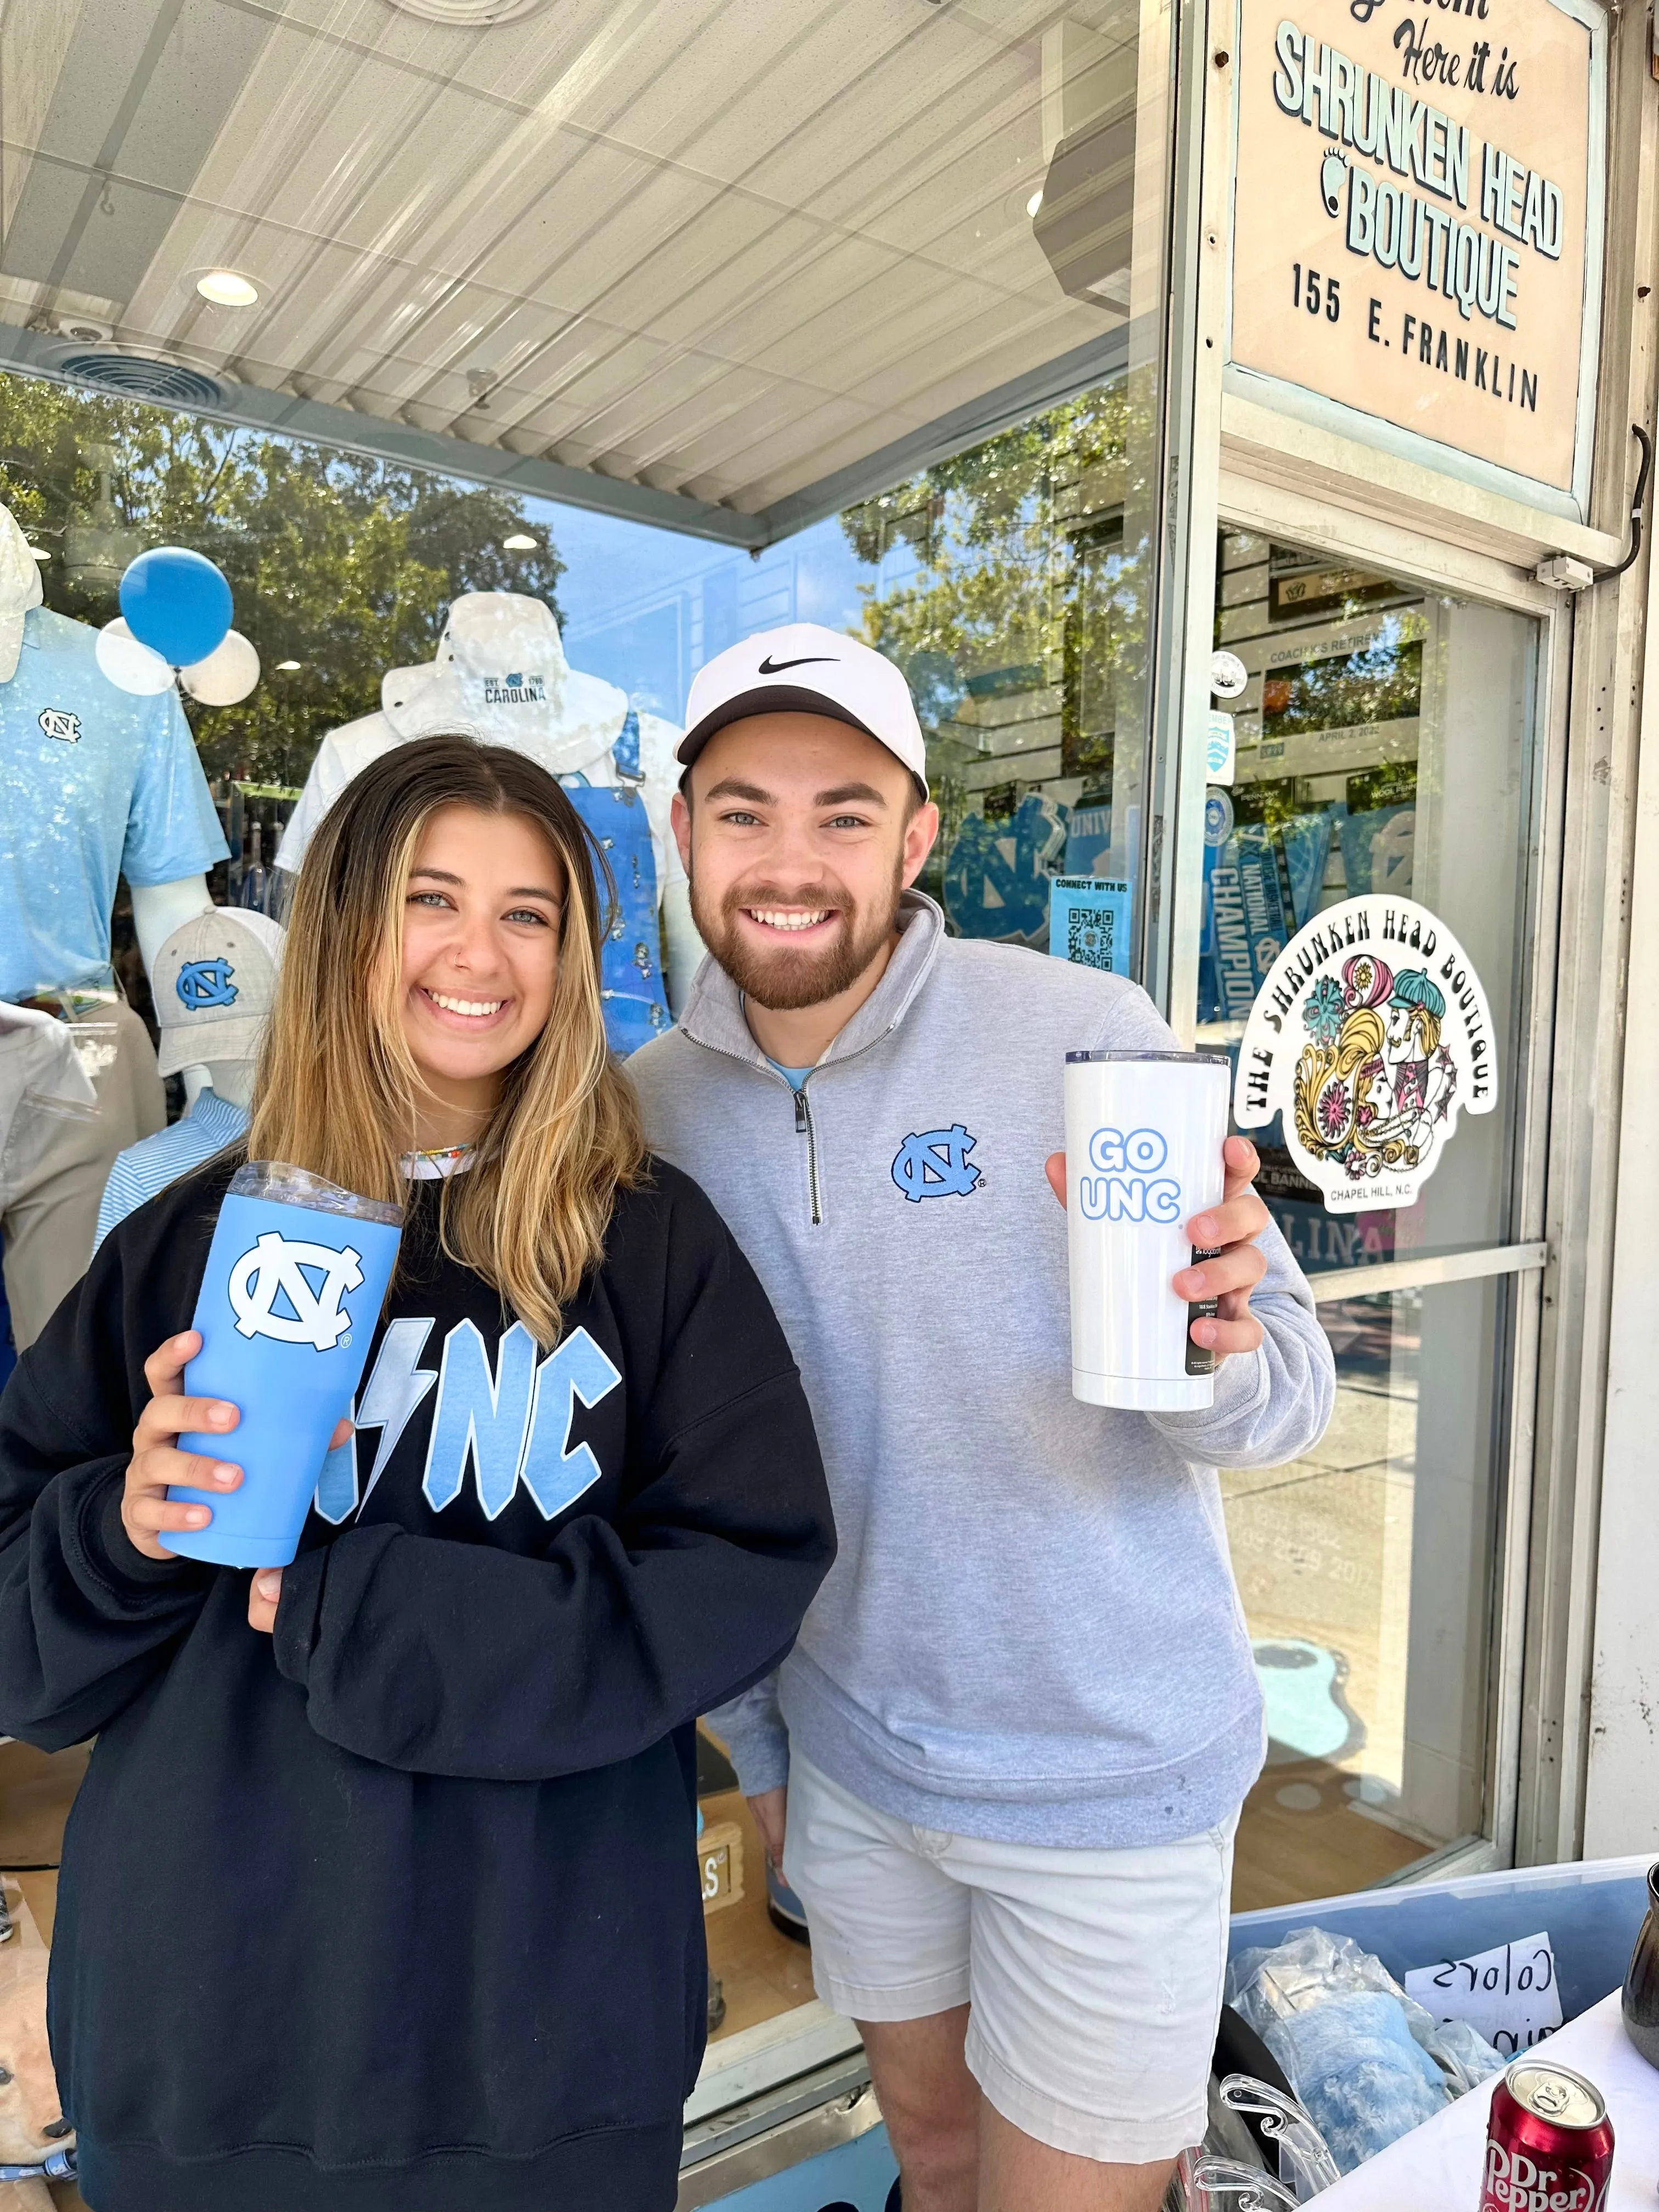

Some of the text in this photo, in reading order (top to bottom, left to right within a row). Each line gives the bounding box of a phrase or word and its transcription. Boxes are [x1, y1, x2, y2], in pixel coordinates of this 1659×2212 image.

[1394, 17, 1519, 99] Here it is
[1273, 20, 1564, 261] SHRUNKEN HEAD
[1346, 165, 1520, 331] BOUTIQUE
[1293, 263, 1538, 413] 155 E. FRANKLIN
[485, 687, 546, 703] CAROLINA
[1318, 731, 1346, 742] APRIL
[1056, 879, 1127, 893] CONNECT WITH US
[1242, 864, 1268, 936] NATIONAL
[1210, 867, 1256, 1019] CHAMPION
[1246, 1046, 1273, 1112] THE
[1263, 910, 1371, 1035] SHRUNKEN
[1441, 952, 1491, 1099] BOUTIQUE
[1089, 1127, 1168, 1174] GO
[1080, 1177, 1181, 1224] UNC
[1330, 1184, 1413, 1201] CHAPEL HILL, N.C.
[1487, 2138, 1586, 2212] Pepper
[1510, 2151, 1557, 2191] Dr
